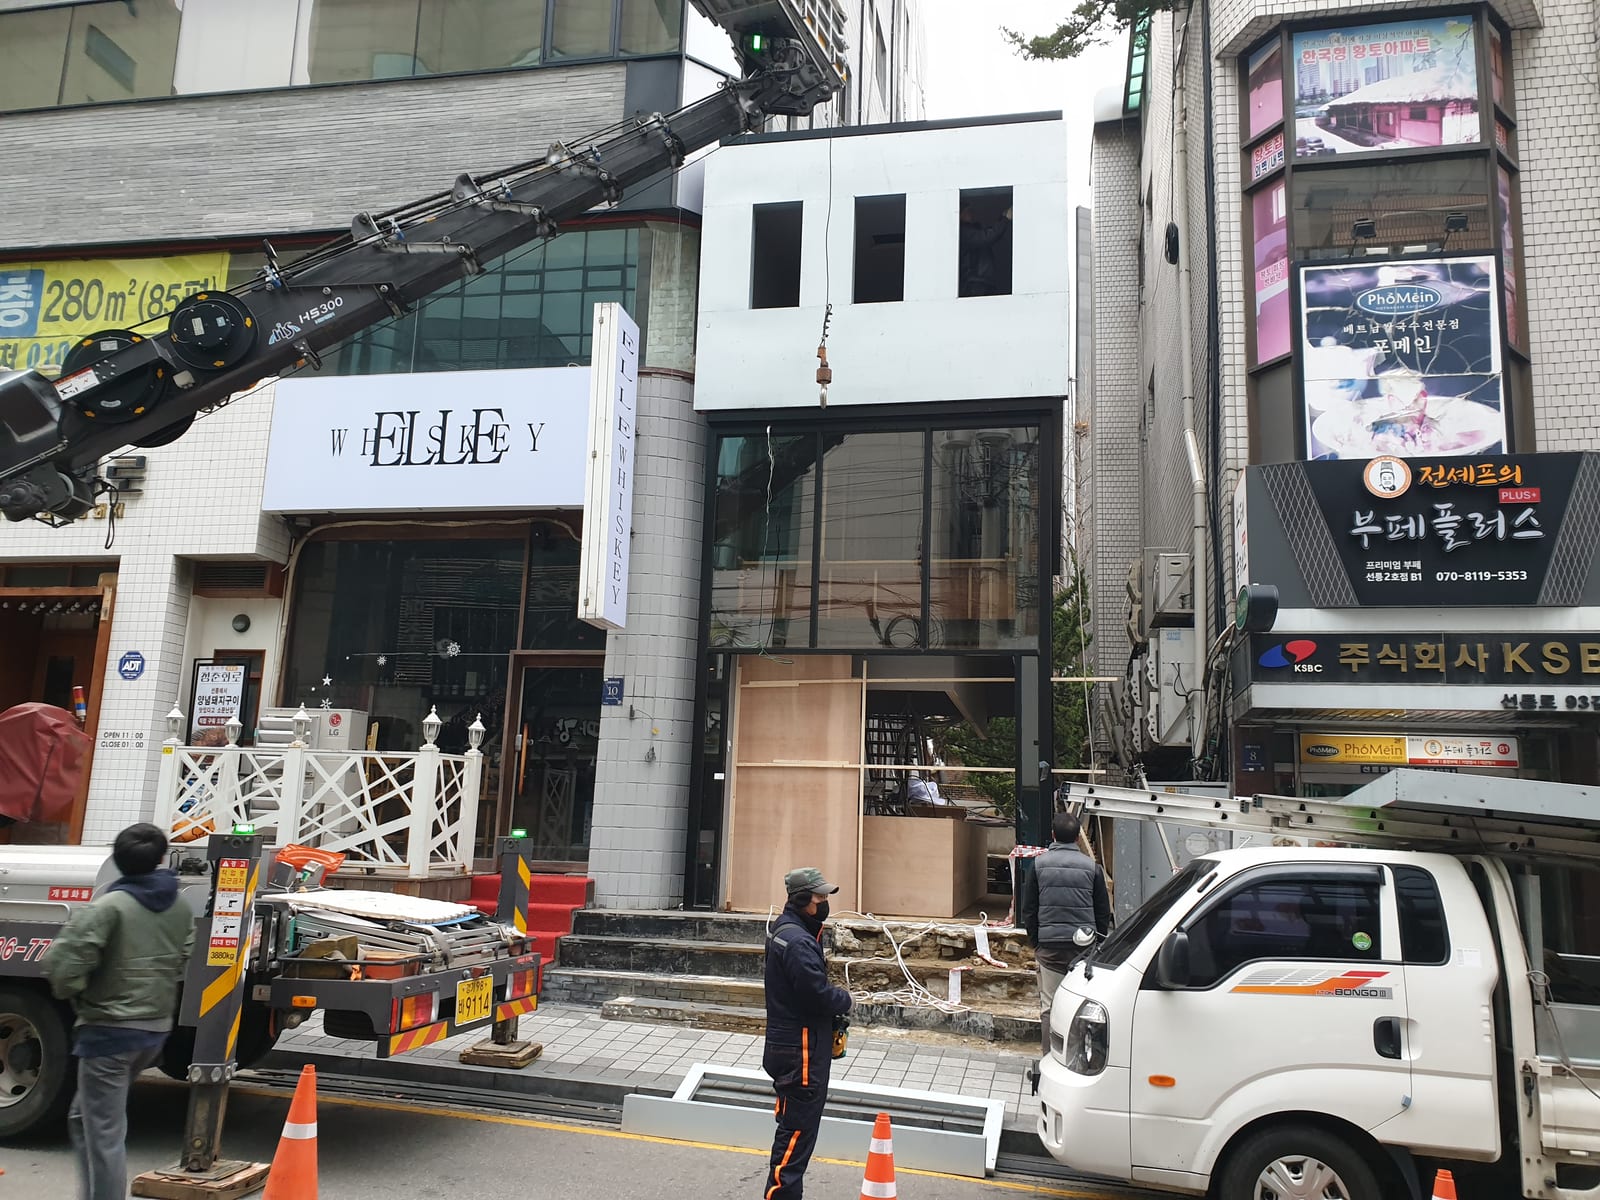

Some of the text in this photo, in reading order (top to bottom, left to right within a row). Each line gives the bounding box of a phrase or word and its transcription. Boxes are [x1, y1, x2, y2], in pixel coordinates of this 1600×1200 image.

[1373, 335, 1432, 354] 포메인
[369, 408, 505, 467] ELLE
[611, 443, 628, 605] WHISKEY
[1365, 560, 1401, 570] 프리미엄
[1365, 572, 1422, 582] 선릉2호점 B1
[1436, 571, 1528, 582] 070-8119-5353
[1339, 642, 1489, 673] 주식회사
[122, 660, 142, 671] ADT
[1294, 663, 1323, 673] KSBC
[608, 686, 619, 696] 10
[197, 695, 240, 706] 양념돼지구이
[103, 731, 120, 739] OPEN
[328, 728, 339, 736] LG
[1499, 745, 1509, 753] B1
[50, 888, 90, 899] 개별화물
[210, 951, 235, 960] 3880kg
[1334, 988, 1378, 997] BONGO
